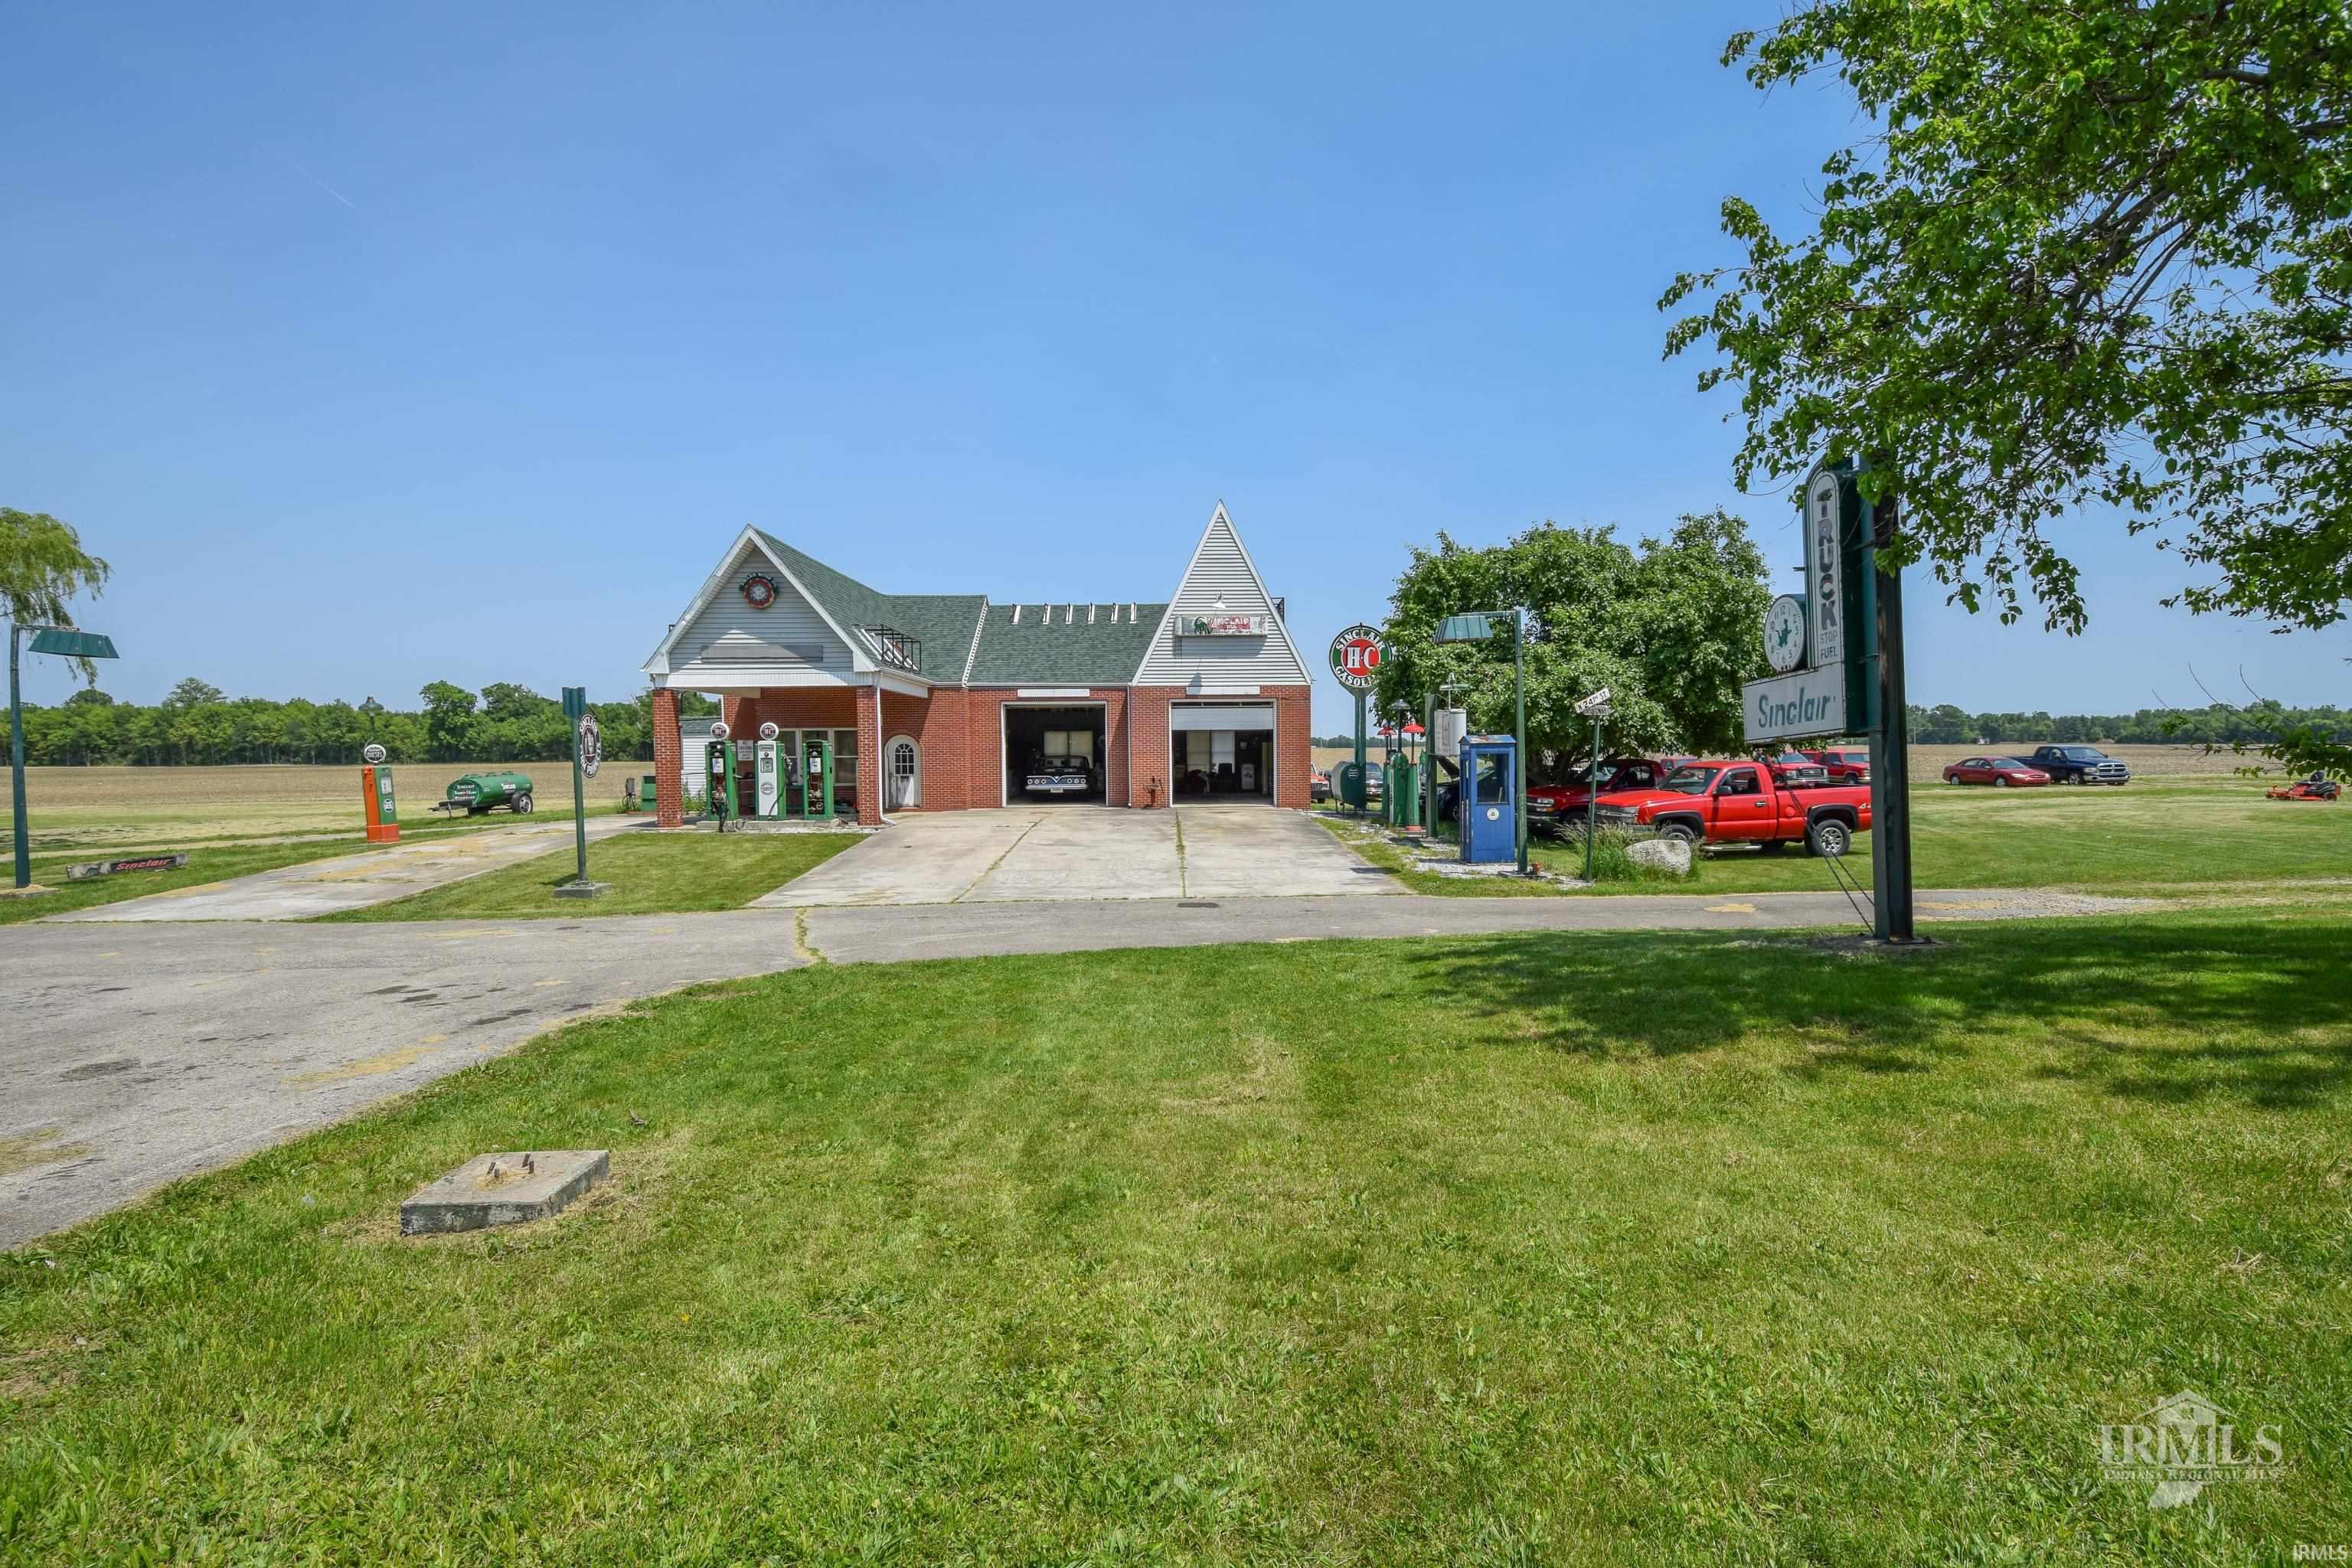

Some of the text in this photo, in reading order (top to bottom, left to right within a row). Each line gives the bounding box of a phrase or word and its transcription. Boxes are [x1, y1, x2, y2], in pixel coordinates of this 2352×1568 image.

[1820, 630, 1838, 644] STOP
[1820, 645, 1838, 659] FUEL
[1335, 665, 1374, 687] GASOLI
[1599, 691, 1606, 700] ST
[1758, 687, 1831, 729] Sinclair
[116, 859, 168, 871] Sinclair
